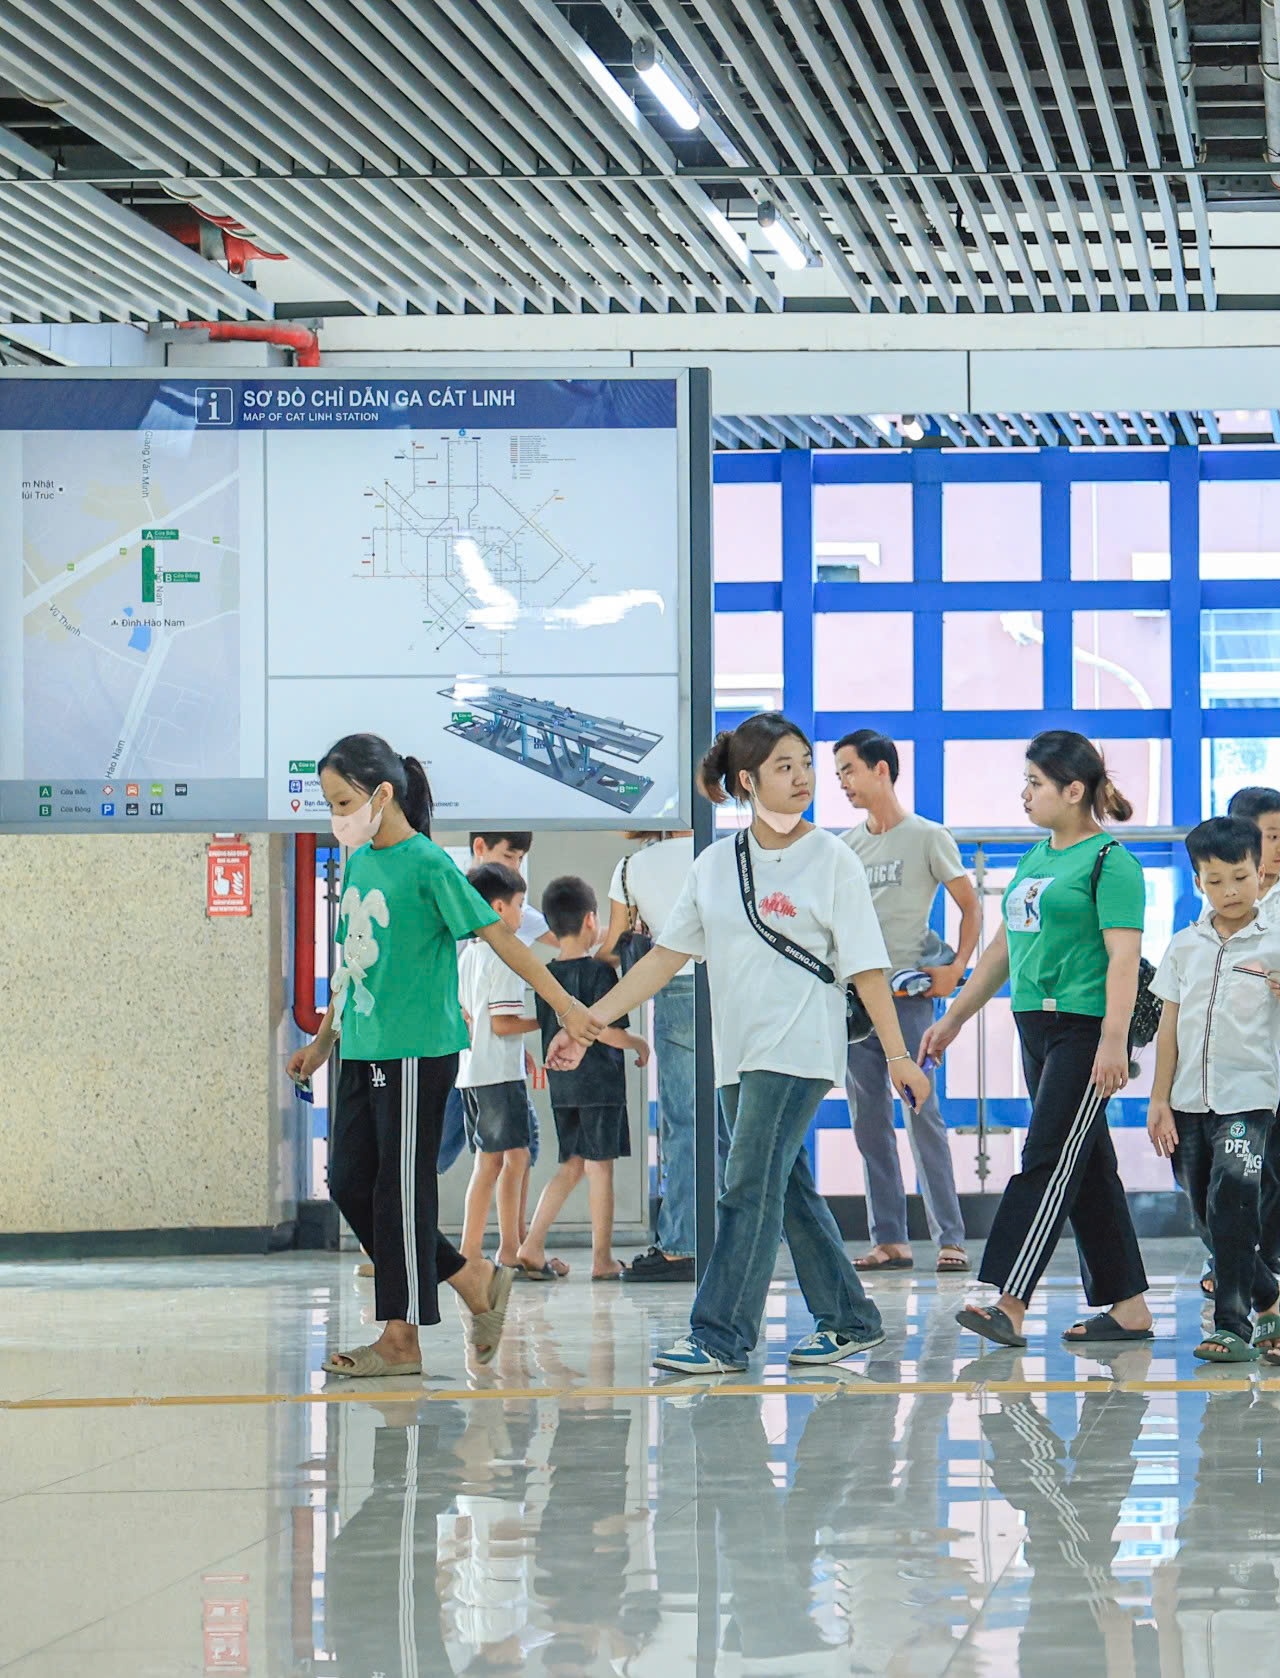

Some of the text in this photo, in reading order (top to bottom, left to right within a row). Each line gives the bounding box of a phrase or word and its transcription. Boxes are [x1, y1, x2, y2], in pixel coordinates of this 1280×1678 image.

[243, 385, 516, 407] SƠ ĐỒ CHỈ DẪN GA CÁT LINH
[243, 412, 379, 422] MAP OF CAT LINH STATION
[145, 531, 154, 540] A
[165, 573, 173, 582] B
[121, 618, 185, 627] Đình Hào Nam
[784, 945, 821, 972] SHENGJIA
[370, 1063, 387, 1088] LA
[1224, 1139, 1251, 1154] DFK
